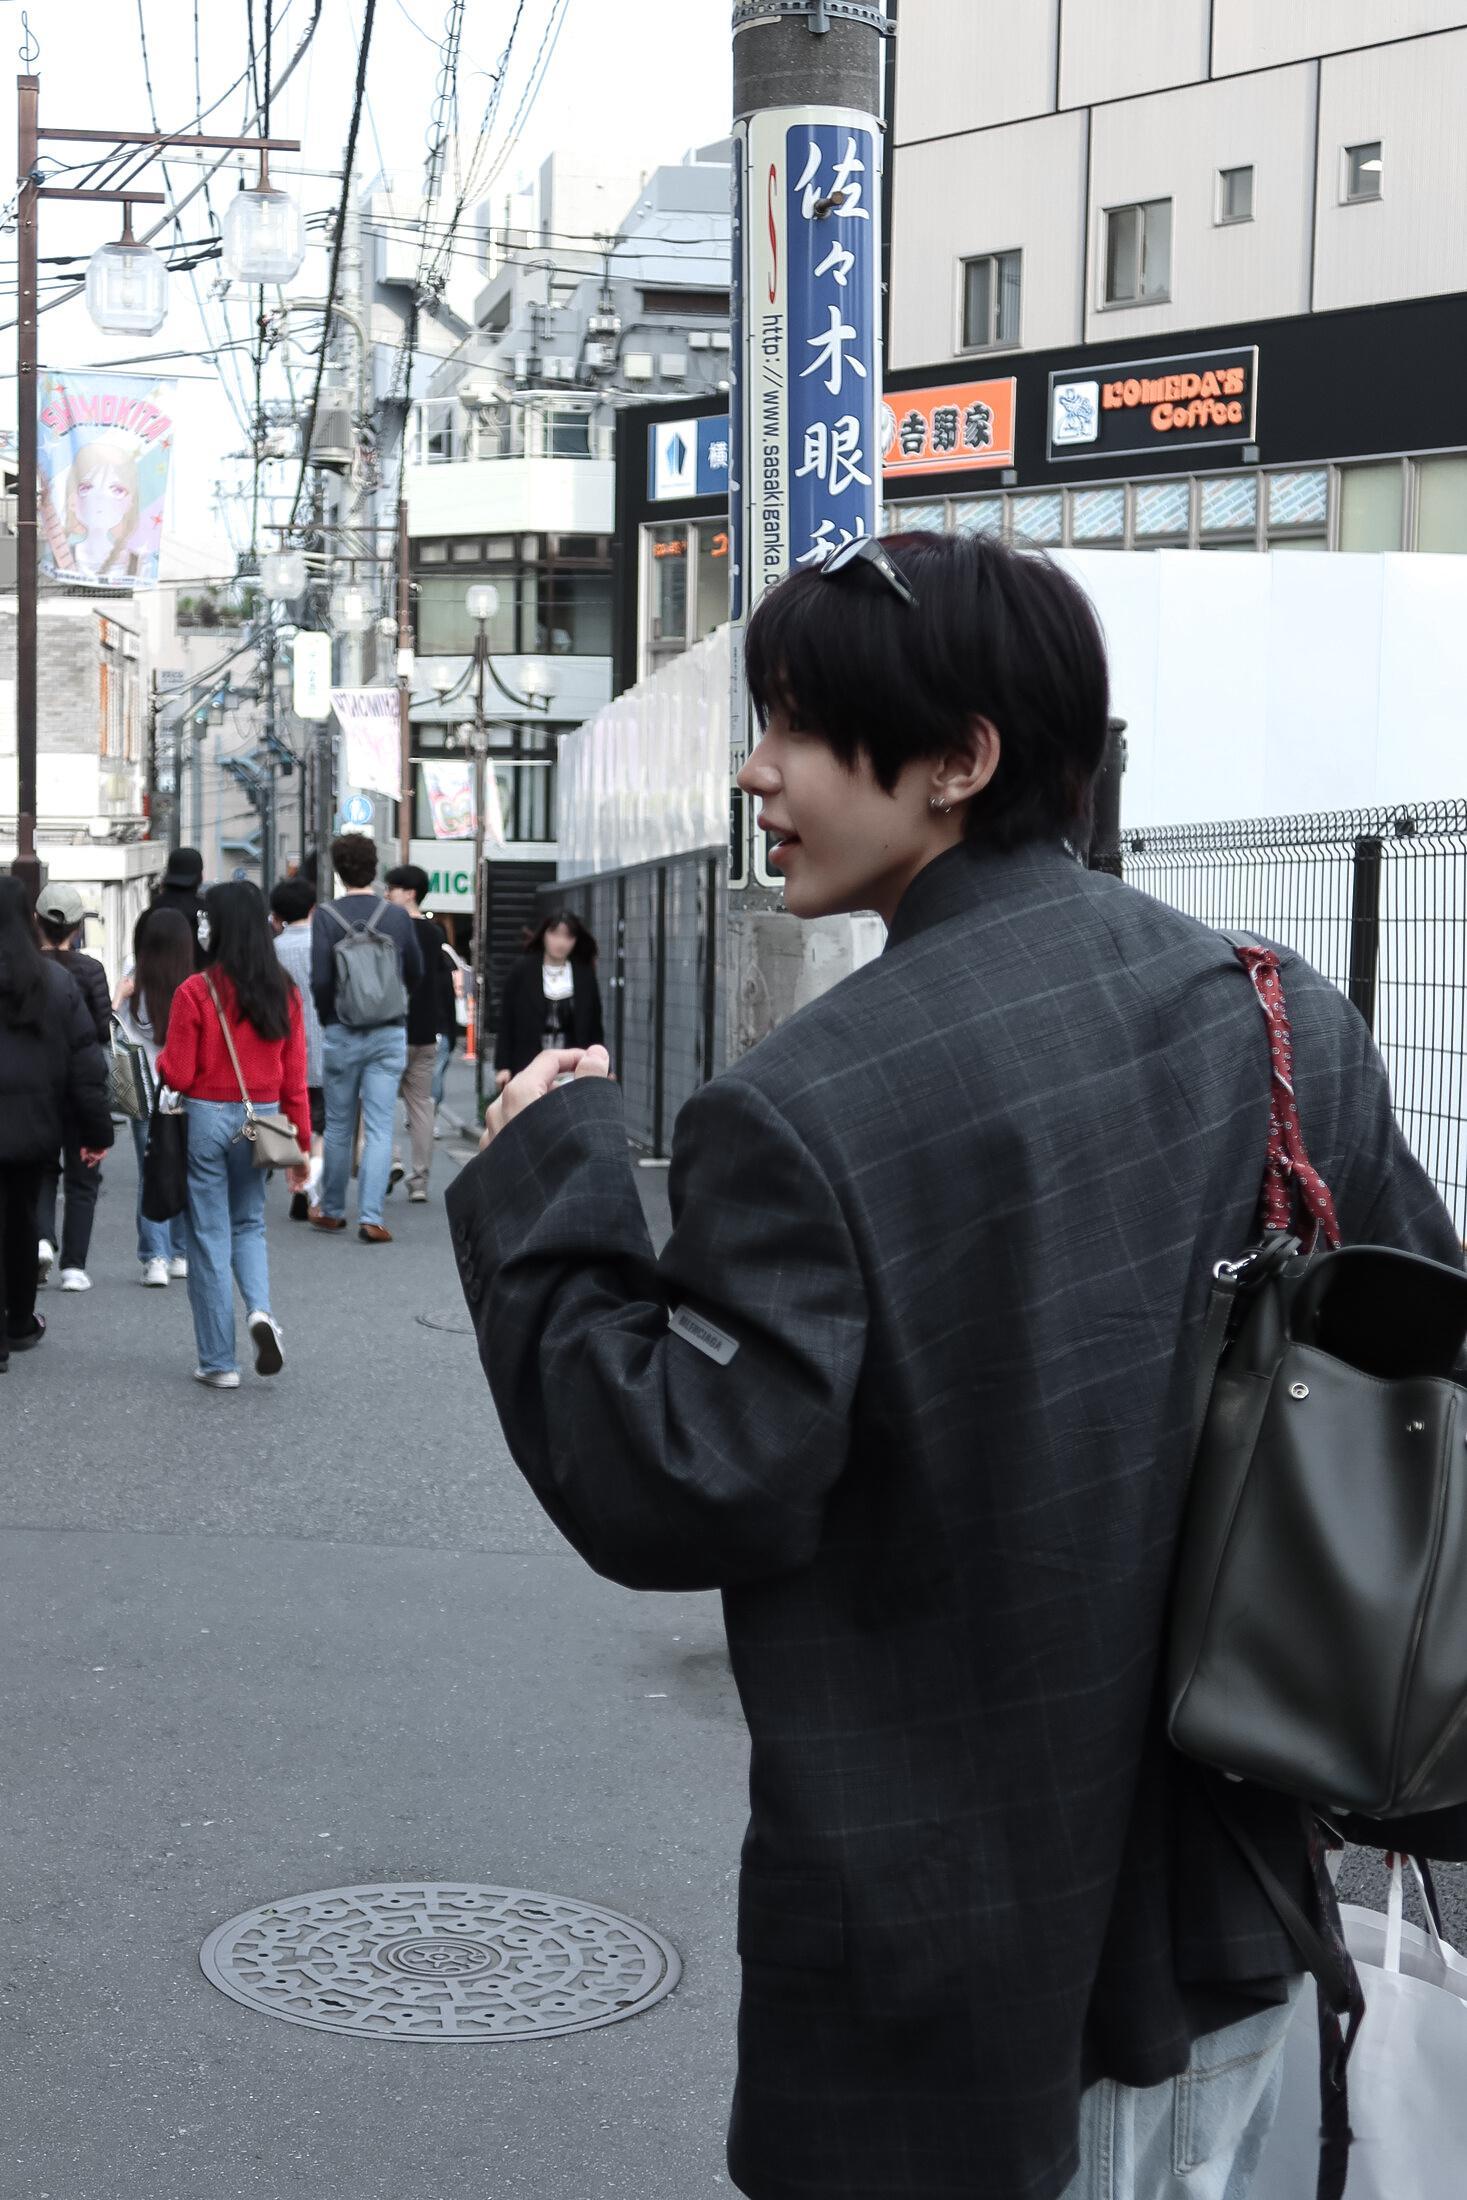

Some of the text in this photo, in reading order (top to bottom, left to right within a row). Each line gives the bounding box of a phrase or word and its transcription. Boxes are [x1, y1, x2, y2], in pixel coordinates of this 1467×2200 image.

[1102, 367, 1245, 409] KOMEDA'S
[41, 394, 172, 442] SHIMOKITA
[1151, 399, 1243, 432] Coffee
